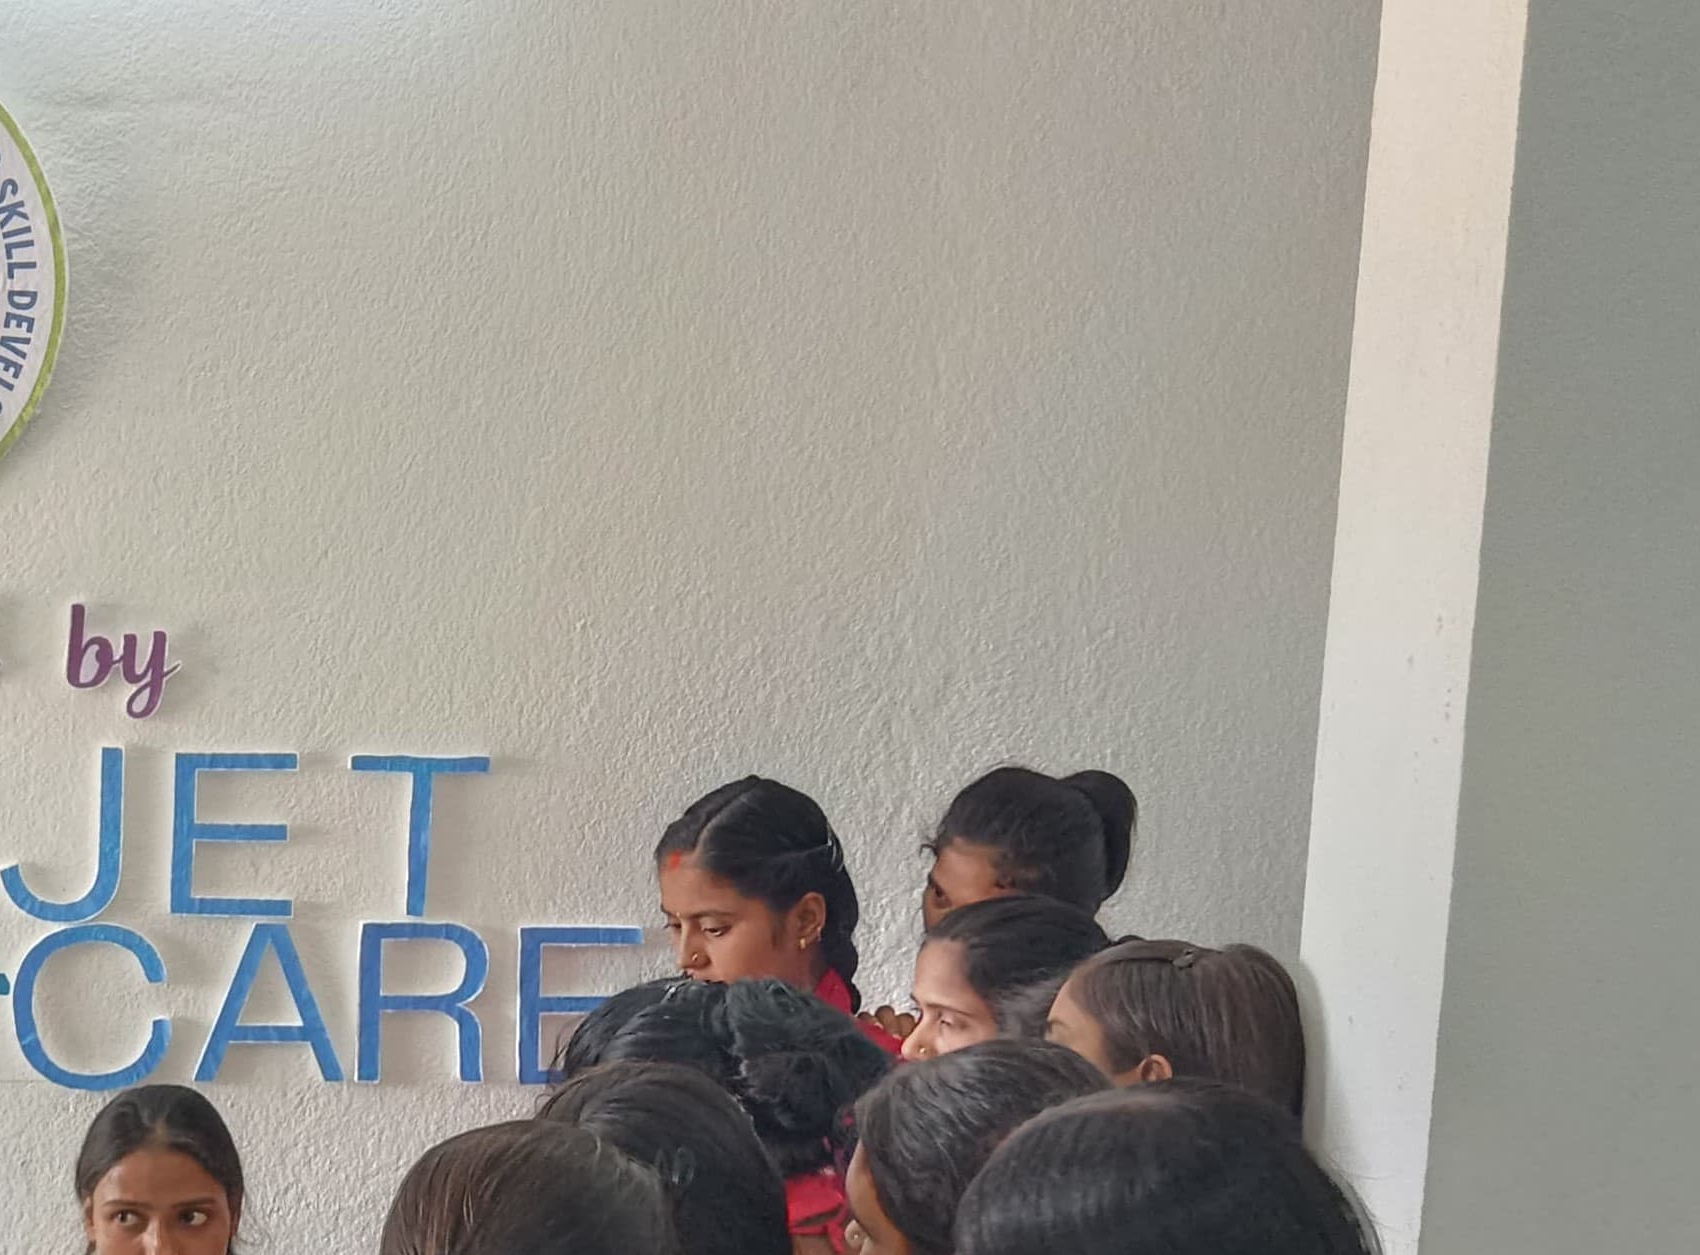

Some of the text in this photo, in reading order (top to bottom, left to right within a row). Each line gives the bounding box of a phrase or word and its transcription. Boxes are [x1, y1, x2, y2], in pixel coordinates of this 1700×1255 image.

[65, 604, 180, 718] by
[0, 746, 490, 921] JET
[12, 922, 643, 1090] CARE
